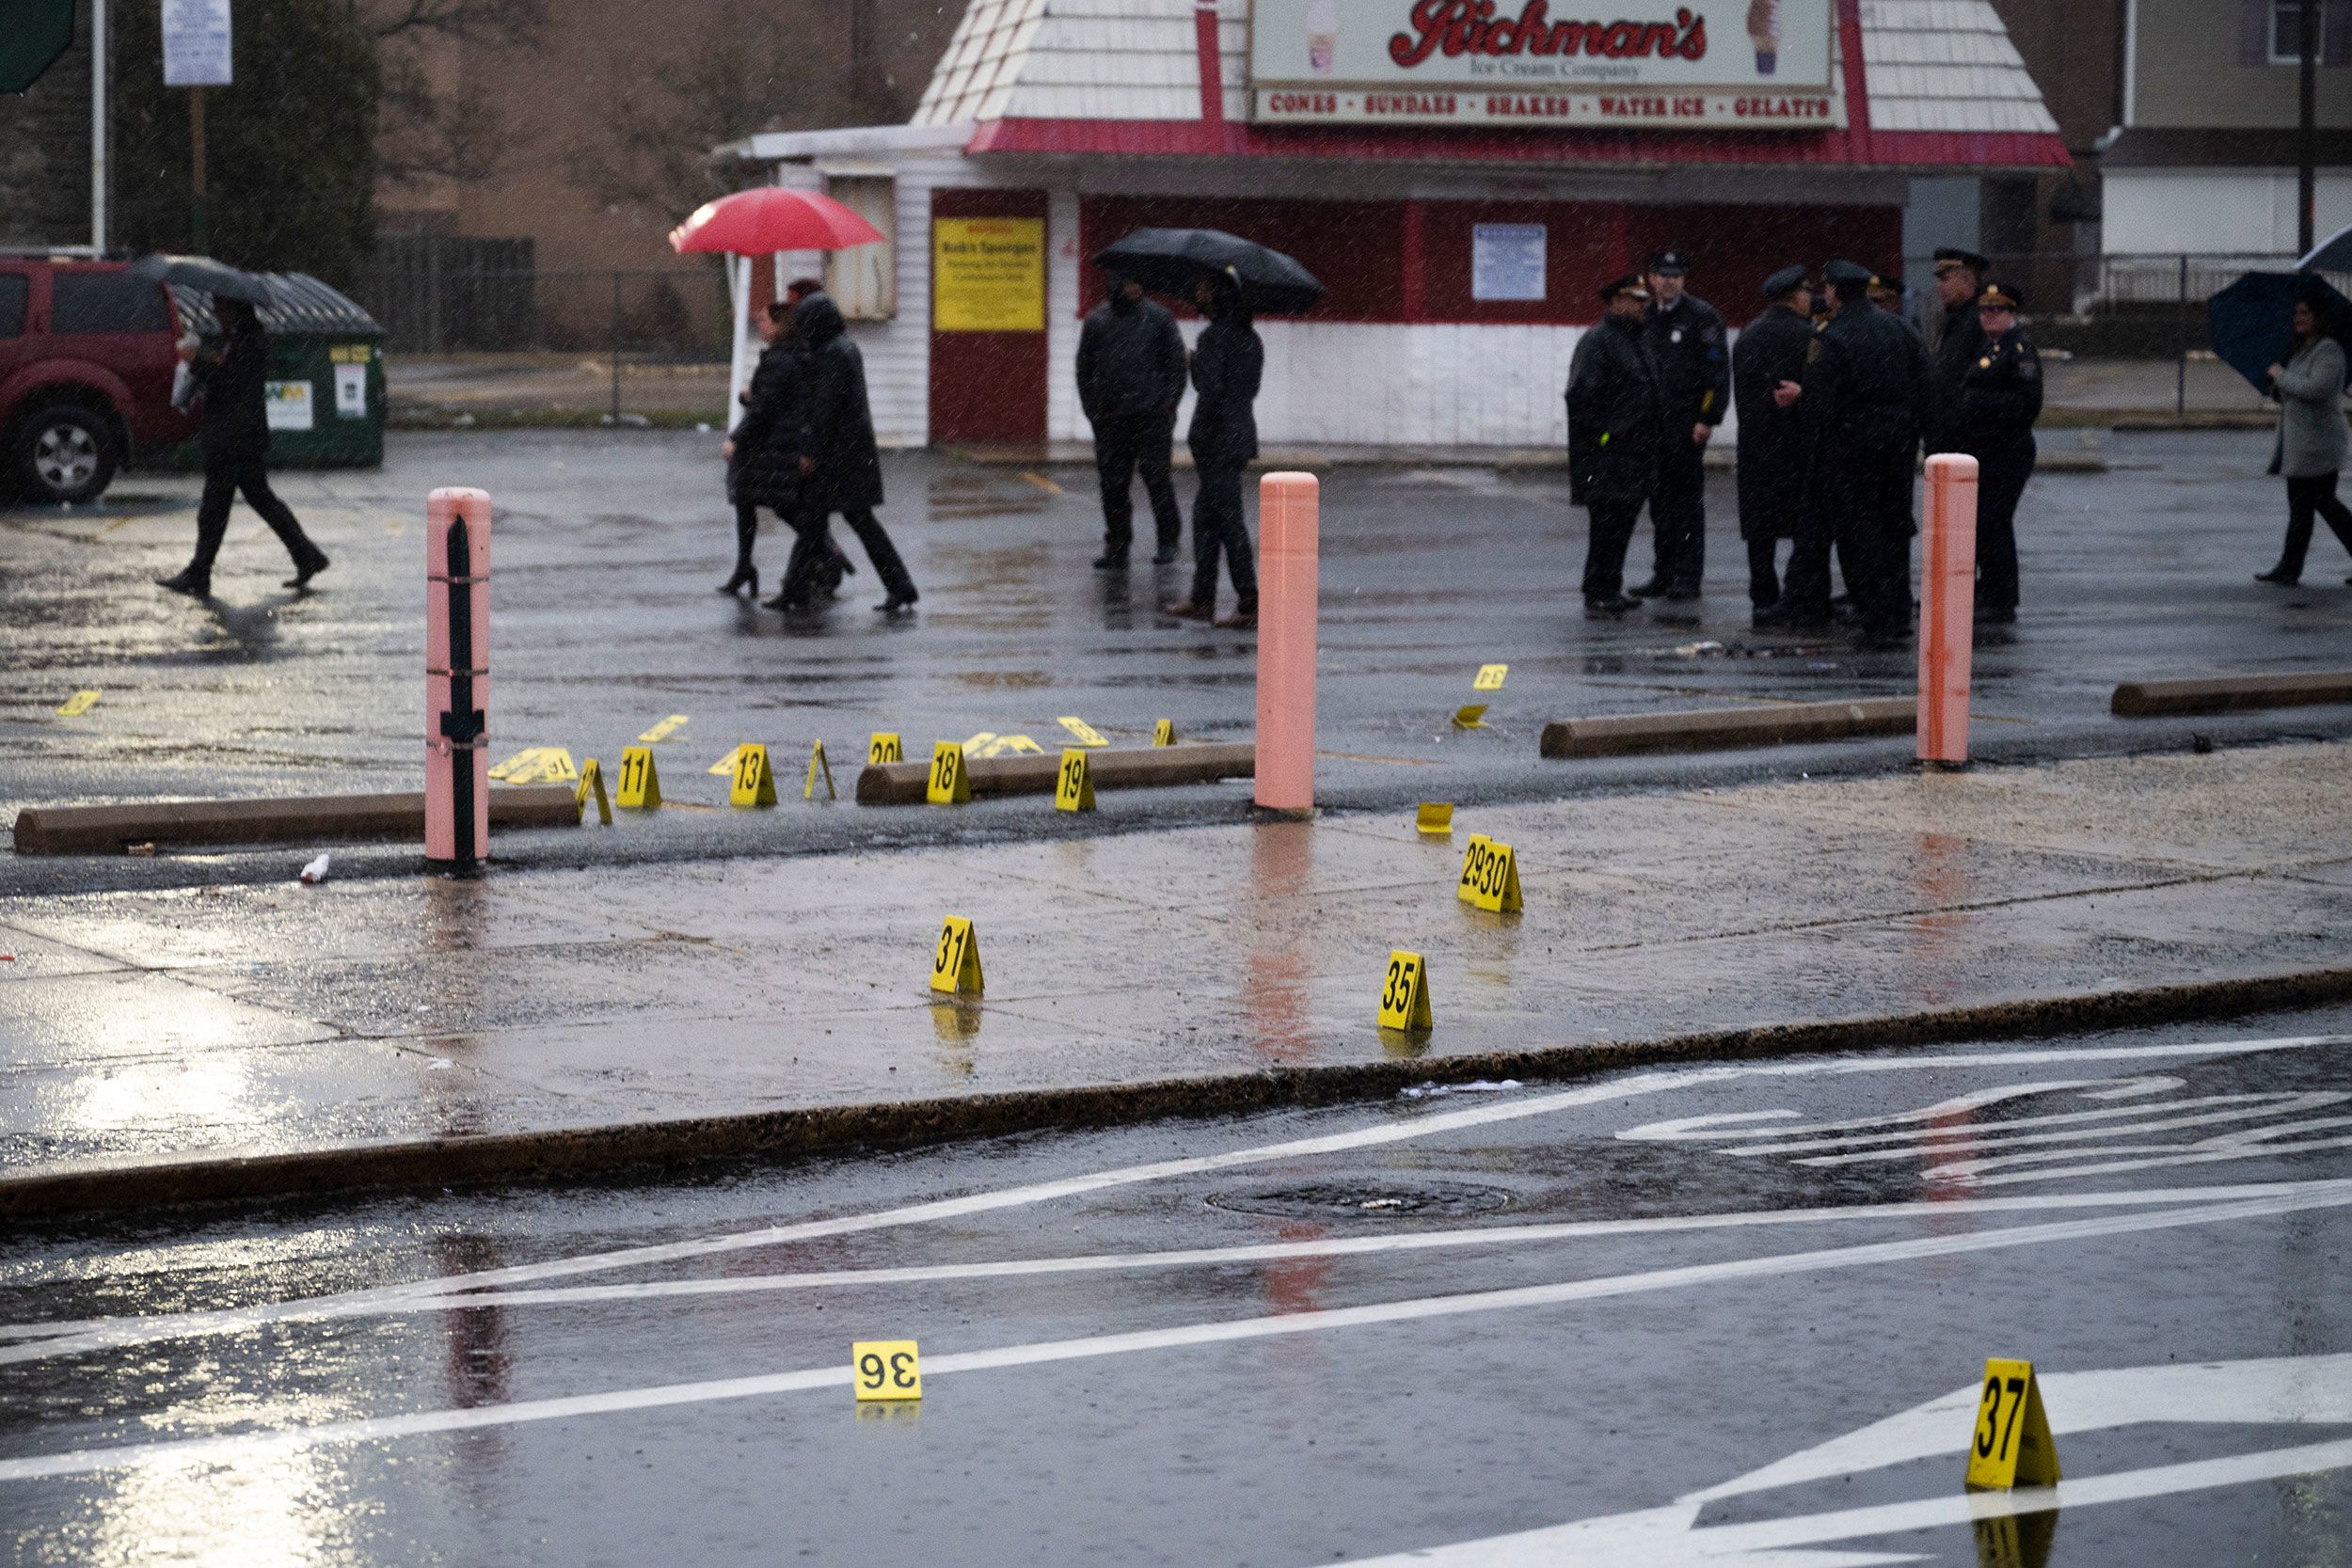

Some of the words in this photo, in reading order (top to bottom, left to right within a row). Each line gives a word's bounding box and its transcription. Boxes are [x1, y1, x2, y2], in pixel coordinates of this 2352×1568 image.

[1388, 0, 1708, 68] Richman's
[1470, 58, 1494, 74] Ice
[1501, 58, 1555, 75] Cream
[1559, 59, 1641, 81] Company
[1270, 94, 1337, 114] CONES
[1365, 94, 1457, 115] SUNDAES
[1486, 95, 1569, 116] SHAKES
[1600, 97, 1667, 117] WATER
[1671, 98, 1705, 117] ICE
[623, 752, 644, 792] 11
[739, 752, 759, 790] 13
[935, 751, 956, 790] 18
[1063, 758, 1082, 800] 19
[935, 925, 965, 977] 31
[1382, 960, 1415, 1013] 35
[860, 1352, 916, 1389] 36
[1977, 1375, 2026, 1462] 37
